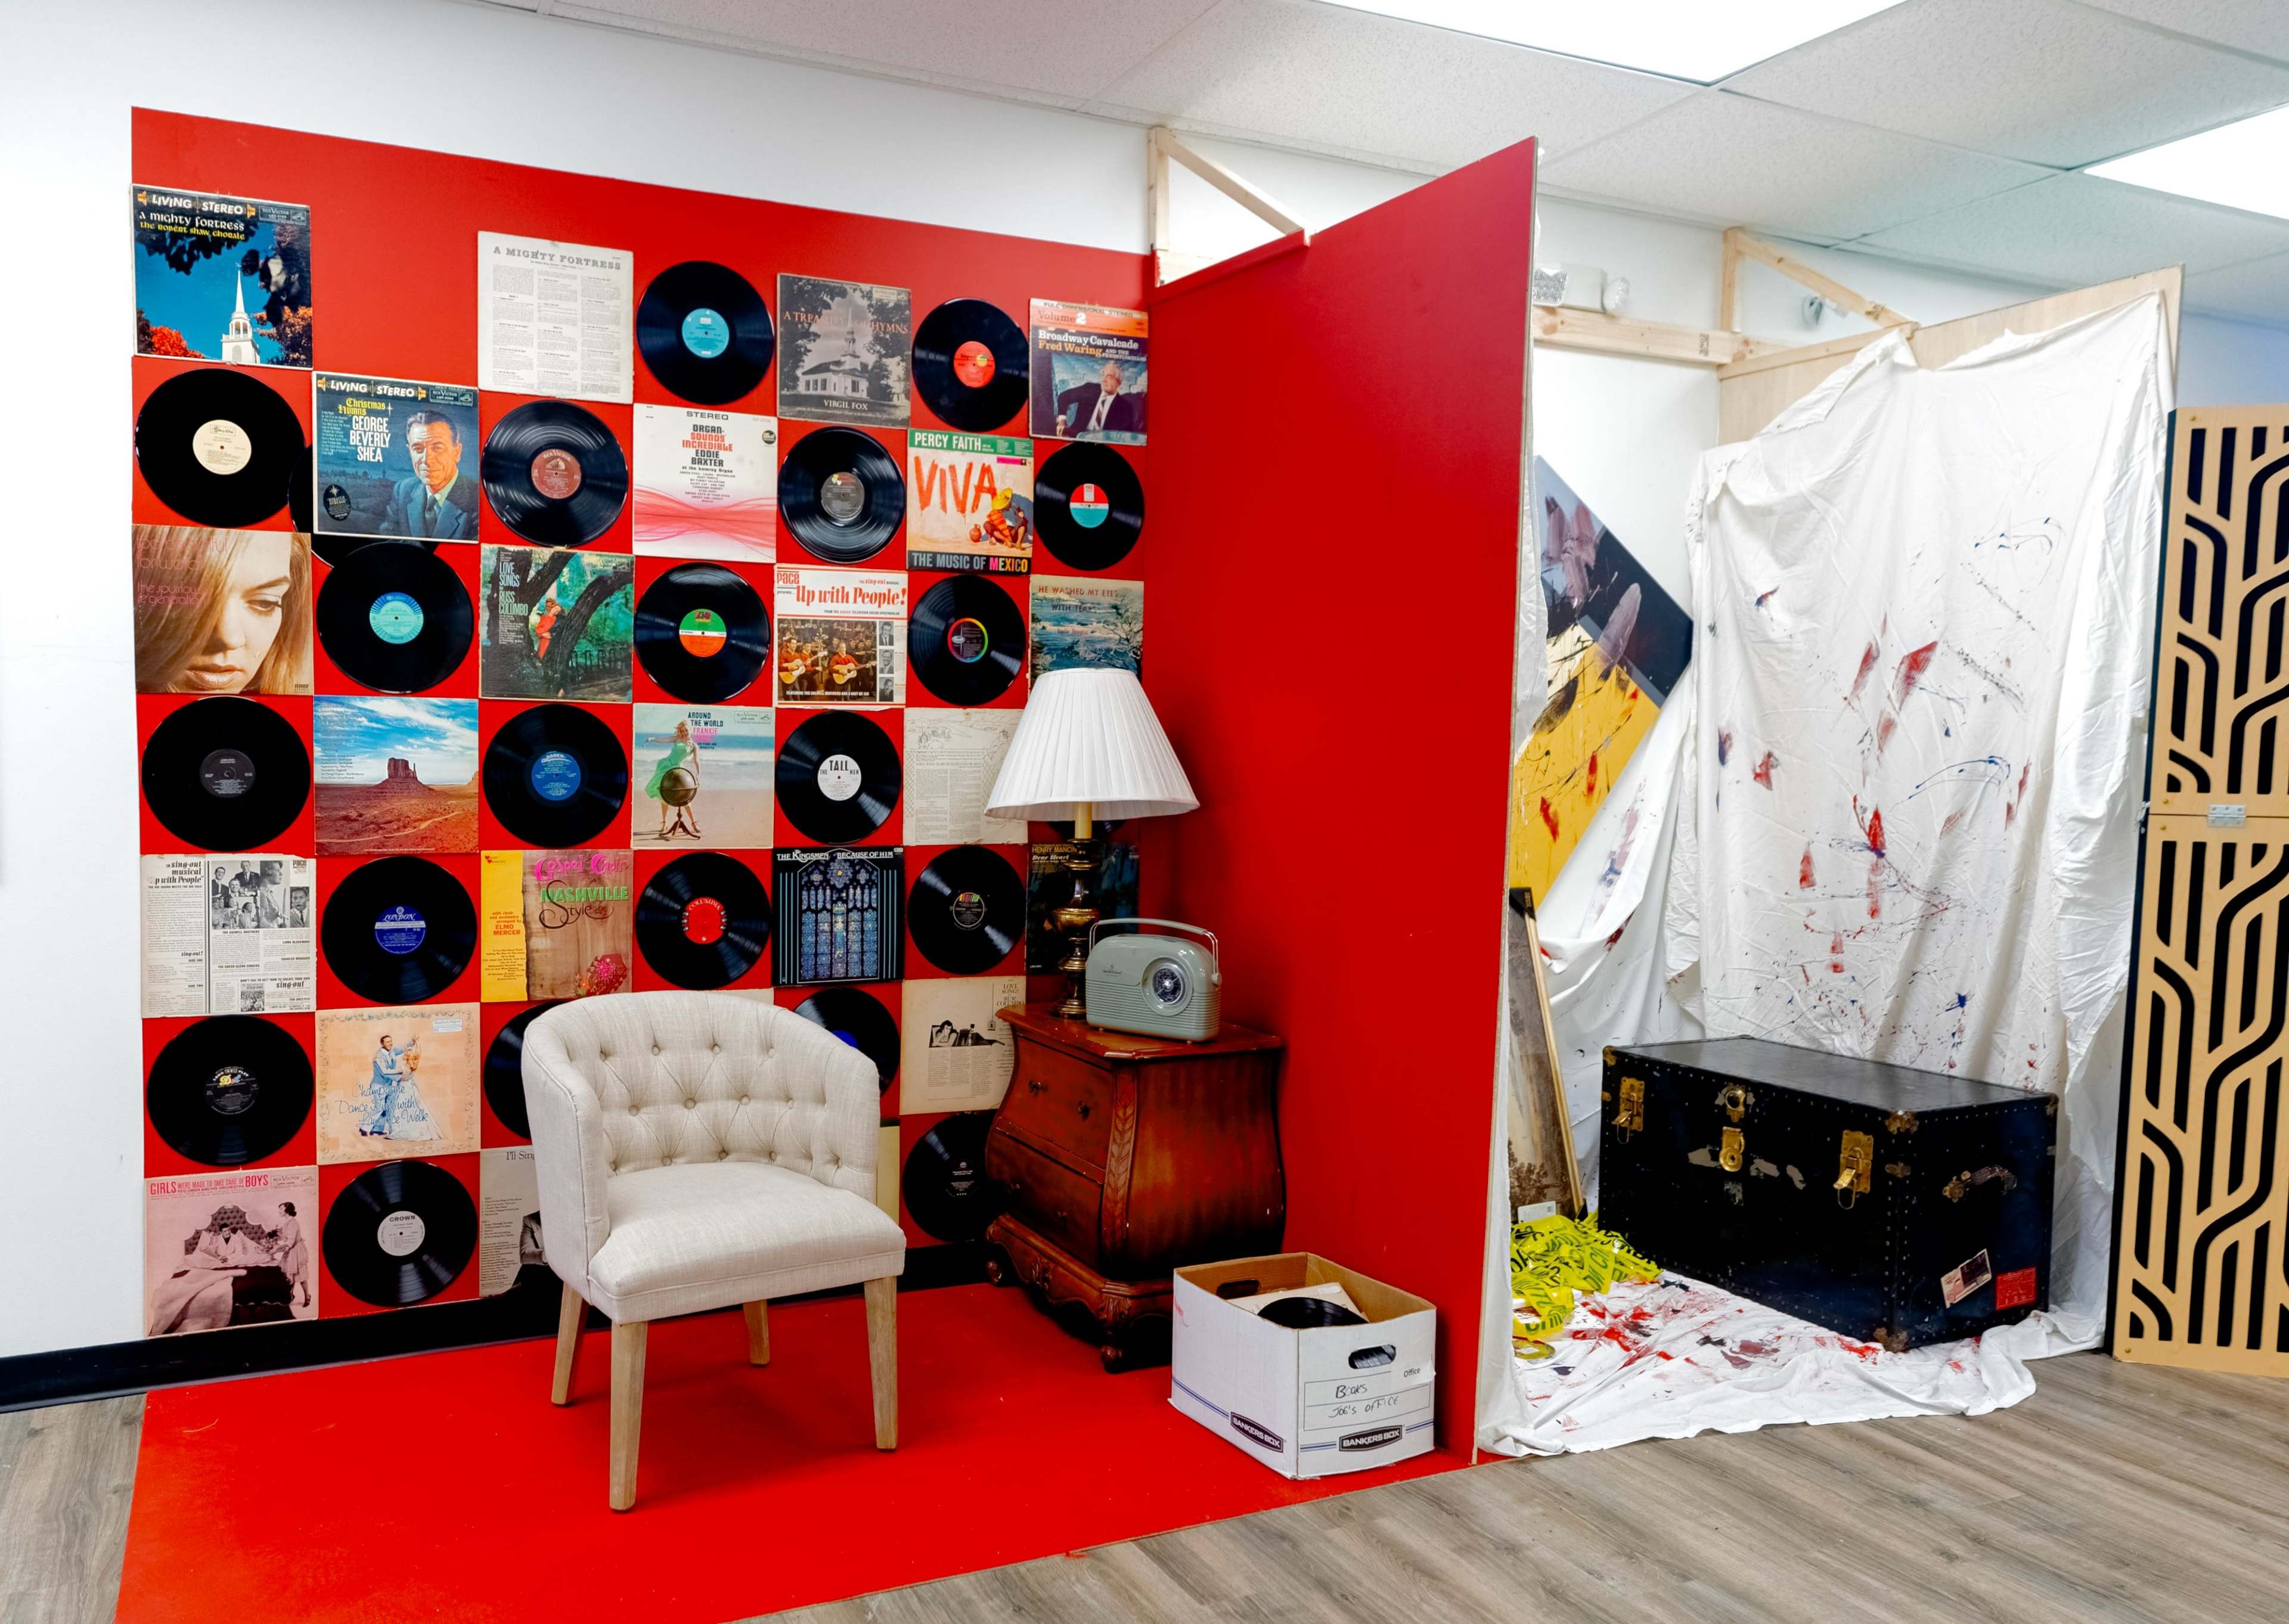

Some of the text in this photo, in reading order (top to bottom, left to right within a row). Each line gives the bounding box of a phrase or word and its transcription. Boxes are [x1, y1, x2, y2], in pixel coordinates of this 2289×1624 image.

[152, 194, 243, 215] LIVING STEREO
[493, 246, 501, 254] A
[506, 247, 555, 261] MIGHTY
[560, 254, 621, 270] FORTRESS
[783, 311, 791, 320] A
[871, 321, 908, 334] HYMNS
[1038, 310, 1087, 325] Volume 2
[1038, 330, 1139, 349] Broadway Cavalcade
[1038, 340, 1062, 350] Fred
[1065, 343, 1102, 358] Waring
[331, 380, 415, 398] LIVING STEREO
[346, 398, 386, 410] Christmas
[824, 399, 869, 411] VIRGIL FOX
[687, 411, 728, 420] STEREO
[352, 415, 389, 433] GEORGE
[350, 430, 391, 448] BEVERLY
[690, 432, 725, 442] SOUNDS
[914, 432, 948, 448] PERCY
[953, 434, 981, 451] FAITH
[682, 440, 733, 452] INCREDIBLE
[357, 446, 383, 462] SHEA
[695, 449, 719, 459] EDDIE
[691, 457, 724, 467] BAXTER
[914, 456, 997, 515] VIVA
[500, 562, 515, 575] LOVE
[912, 552, 1028, 572] THE MUSIC OF MEXICO
[499, 574, 519, 587] SONGS
[499, 591, 515, 603] RUSS
[796, 585, 907, 608] Up with People!
[1052, 586, 1084, 595] WASHED
[499, 602, 528, 616] COLUMBO
[829, 760, 849, 771] TALL
[792, 851, 830, 863] KINGSMEN
[171, 861, 201, 869] sing-out
[534, 854, 584, 882] Gospel
[541, 886, 629, 902] NASHVILLE
[539, 880, 614, 929] Style
[688, 898, 720, 911] COLUMBIA
[383, 913, 416, 923] LONDON
[276, 981, 305, 989] sing-out
[352, 1083, 405, 1098] Champagne
[335, 1100, 368, 1114] Dance
[397, 1095, 415, 1110] with
[401, 1109, 429, 1123] Welk
[506, 1151, 516, 1161] I'll
[150, 1181, 176, 1195] GIRLS
[245, 1175, 269, 1188] BOYS
[1232, 1416, 1280, 1448] BANKERS BOX
[1342, 1429, 1400, 1447] BANKERS BOX
